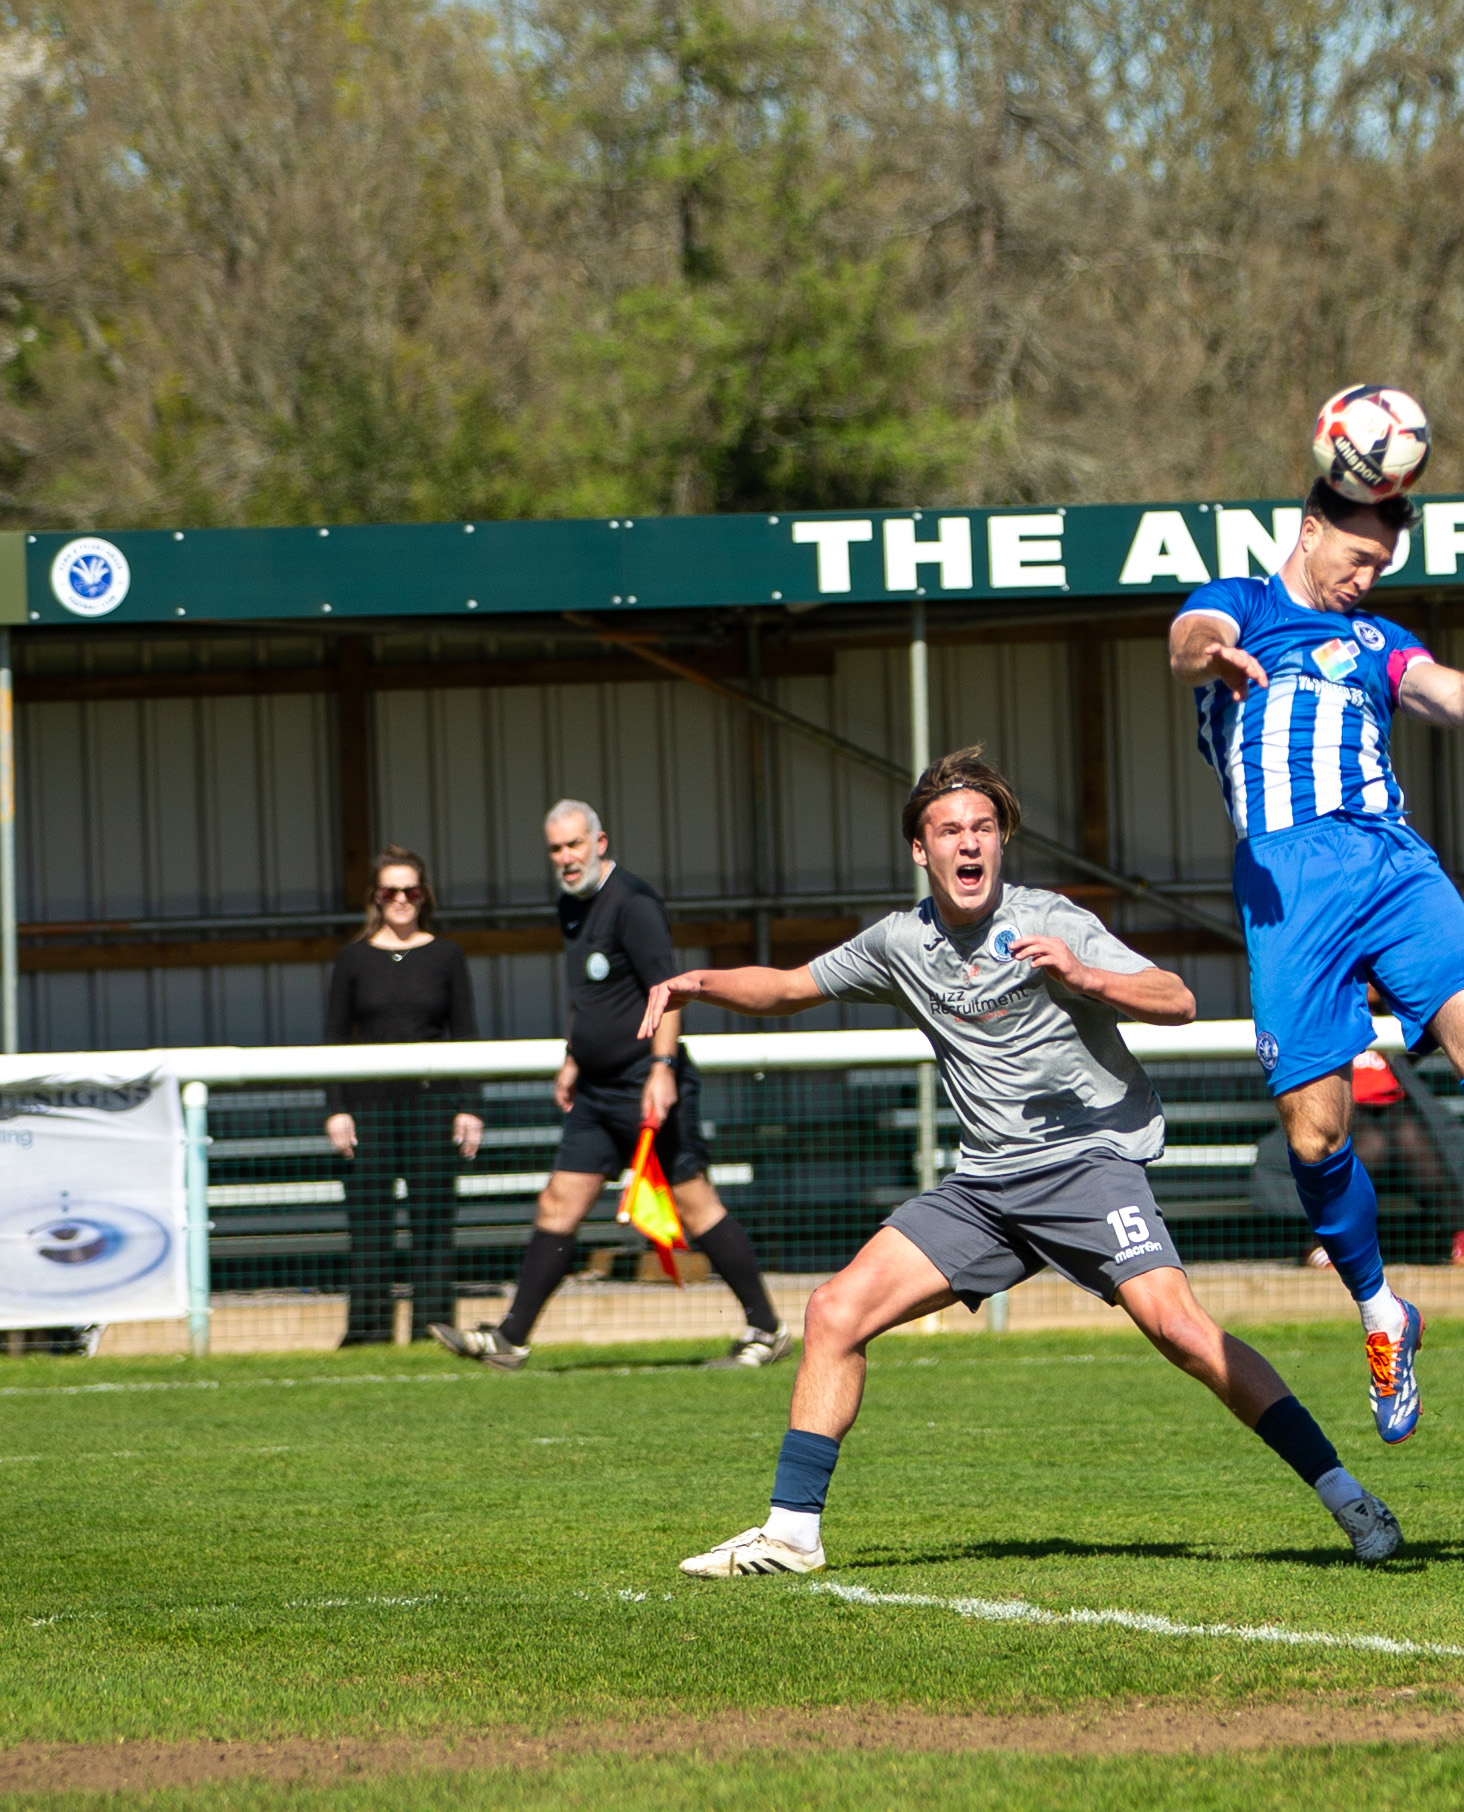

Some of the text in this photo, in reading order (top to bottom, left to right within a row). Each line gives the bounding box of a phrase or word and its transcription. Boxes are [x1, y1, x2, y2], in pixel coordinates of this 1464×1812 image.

[1335, 436, 1383, 486] uhlsport
[792, 514, 1066, 593] THE
[0, 1128, 34, 1150] ing
[1106, 1205, 1150, 1249] 15
